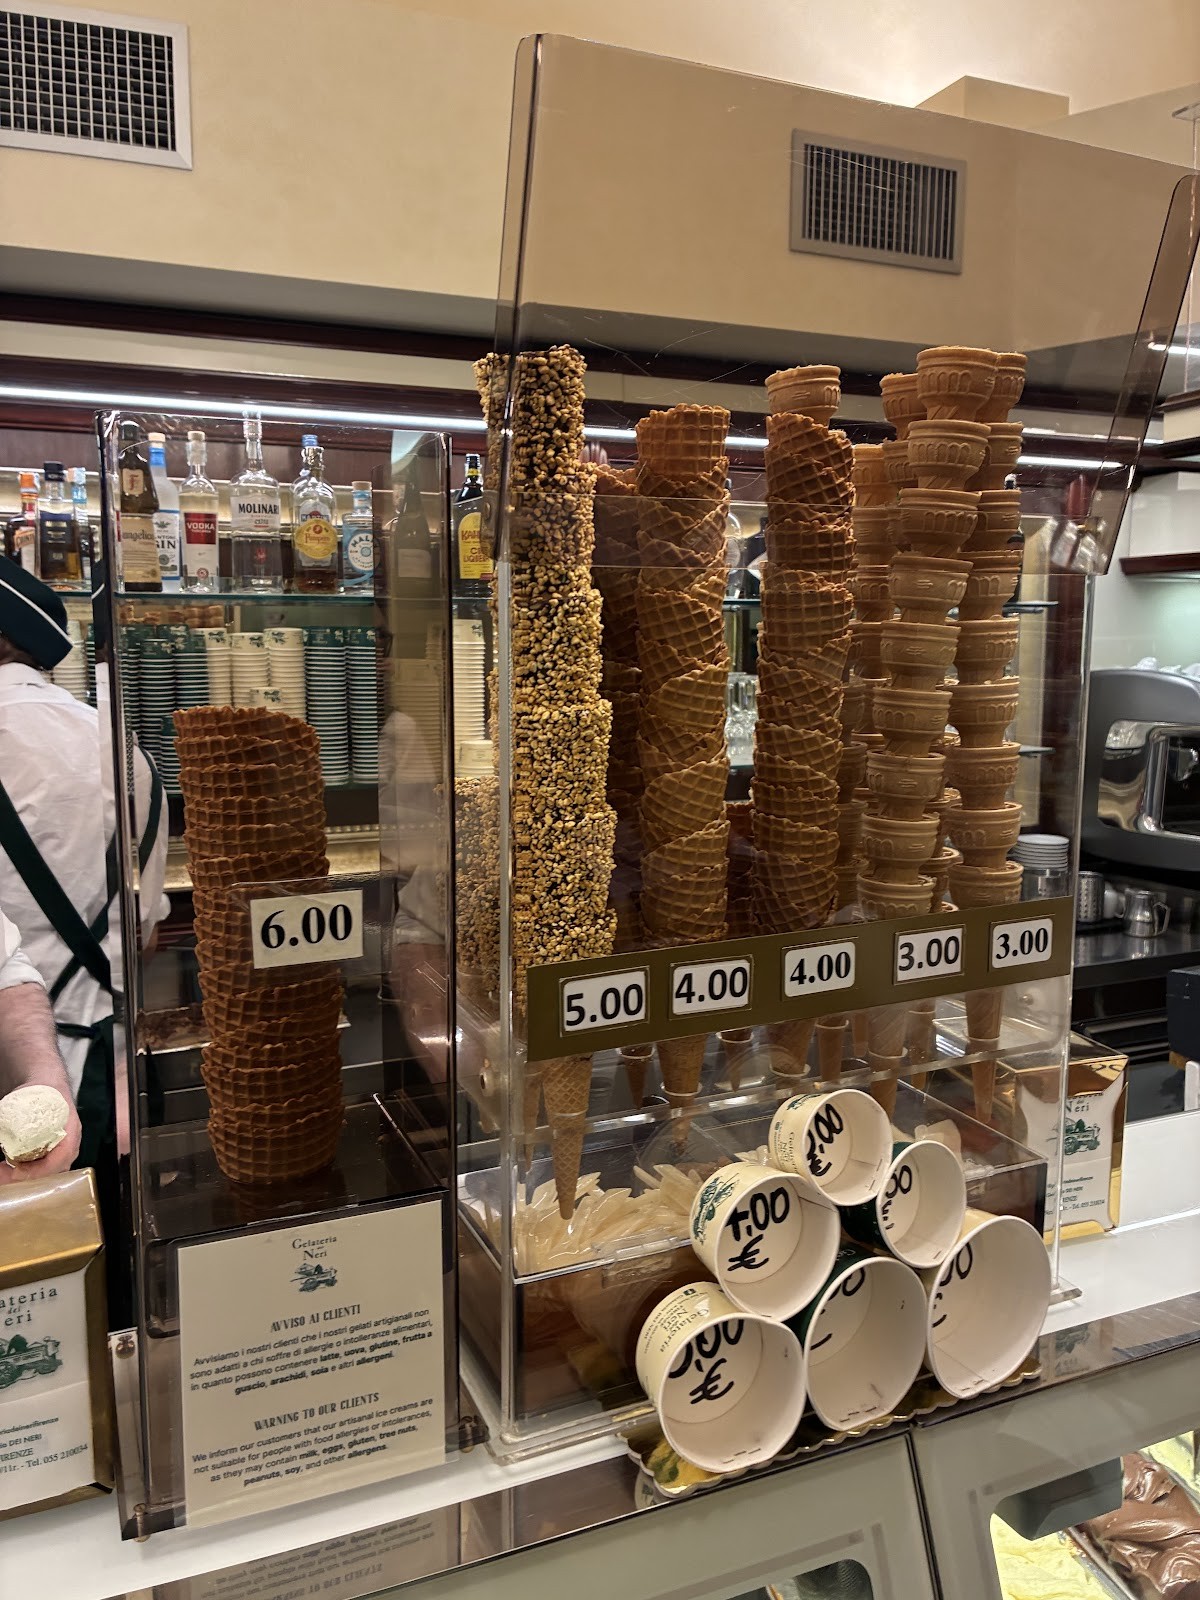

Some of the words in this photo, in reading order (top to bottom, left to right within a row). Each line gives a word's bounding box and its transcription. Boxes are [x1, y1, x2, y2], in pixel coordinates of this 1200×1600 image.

[186, 521, 215, 530] VODKA
[350, 535, 370, 548] MAL
[261, 904, 353, 949] 6.00
[995, 927, 1049, 960] 3.00
[789, 951, 851, 986] 4.00
[898, 935, 960, 972] 3.00
[674, 966, 748, 1004] 4.00
[566, 983, 643, 1027] 5.00
[292, 1236, 337, 1250] Gelateria
[303, 1248, 327, 1260] Neri
[4, 1310, 32, 1326] eri
[271, 1316, 305, 1333] AVVISO
[310, 1313, 320, 1325] AI
[323, 1304, 361, 1321] CLIENTI
[190, 1368, 212, 1380] sono
[214, 1362, 241, 1374] adatti
[250, 1357, 264, 1367] chi
[266, 1350, 291, 1362] soffre
[293, 1348, 301, 1357] di
[304, 1341, 334, 1355] allergie
[344, 1330, 391, 1345] intolleranze
[392, 1320, 433, 1335] alimentari,
[194, 1350, 240, 1366] Avvisiamo
[246, 1342, 272, 1355] nostri
[273, 1336, 299, 1349] clienti
[301, 1333, 317, 1343] che
[324, 1326, 348, 1338] nostri
[349, 1320, 372, 1334] gelati
[374, 1312, 413, 1327] artigianali
[414, 1309, 429, 1318] non
[202, 1377, 233, 1390] quanto
[235, 1368, 272, 1384] possono
[274, 1357, 318, 1372] contenere
[320, 1352, 342, 1362] latte,
[344, 1346, 367, 1357] uova,
[369, 1339, 401, 1353] glutine,
[402, 1332, 426, 1344] frutta
[234, 1380, 268, 1396] guscio,
[270, 1370, 309, 1386] arachidi,
[310, 1366, 329, 1377] soia
[338, 1360, 355, 1370] altri
[356, 1350, 395, 1365] allergeni.
[689, 1358, 734, 1404] €
[254, 1412, 299, 1431] WARNING
[302, 1408, 315, 1420] TO
[318, 1403, 337, 1416] OUR
[340, 1392, 380, 1410] CLIENTS
[24, 1434, 42, 1444] NERI
[192, 1454, 208, 1463] We
[209, 1446, 238, 1459] inform
[240, 1442, 255, 1452] our
[256, 1430, 302, 1448] customers
[304, 1426, 321, 1436] that
[322, 1422, 337, 1432] our
[338, 1412, 374, 1427] artisanal
[376, 1410, 388, 1418] ice
[390, 1402, 419, 1414] creams
[420, 1398, 433, 1407] are
[194, 1465, 209, 1475] not
[212, 1456, 246, 1471] suitable
[248, 1452, 260, 1461] for
[262, 1444, 292, 1460] people
[294, 1439, 313, 1450] with
[314, 1434, 334, 1445] food
[336, 1425, 370, 1440] allergies
[371, 1423, 380, 1431] or
[382, 1410, 432, 1428] intolerances,
[26, 1458, 43, 1468] Tel.
[44, 1453, 59, 1464] 055
[222, 1468, 244, 1479] they
[245, 1464, 264, 1474] may
[266, 1455, 298, 1468] contain
[322, 1444, 346, 1455] eggs,
[348, 1436, 378, 1449] gluten,
[379, 1430, 396, 1439] tree
[244, 1470, 284, 1487] peanuts,
[285, 1465, 304, 1475] soy,
[306, 1460, 322, 1470] and
[323, 1454, 346, 1466] other
